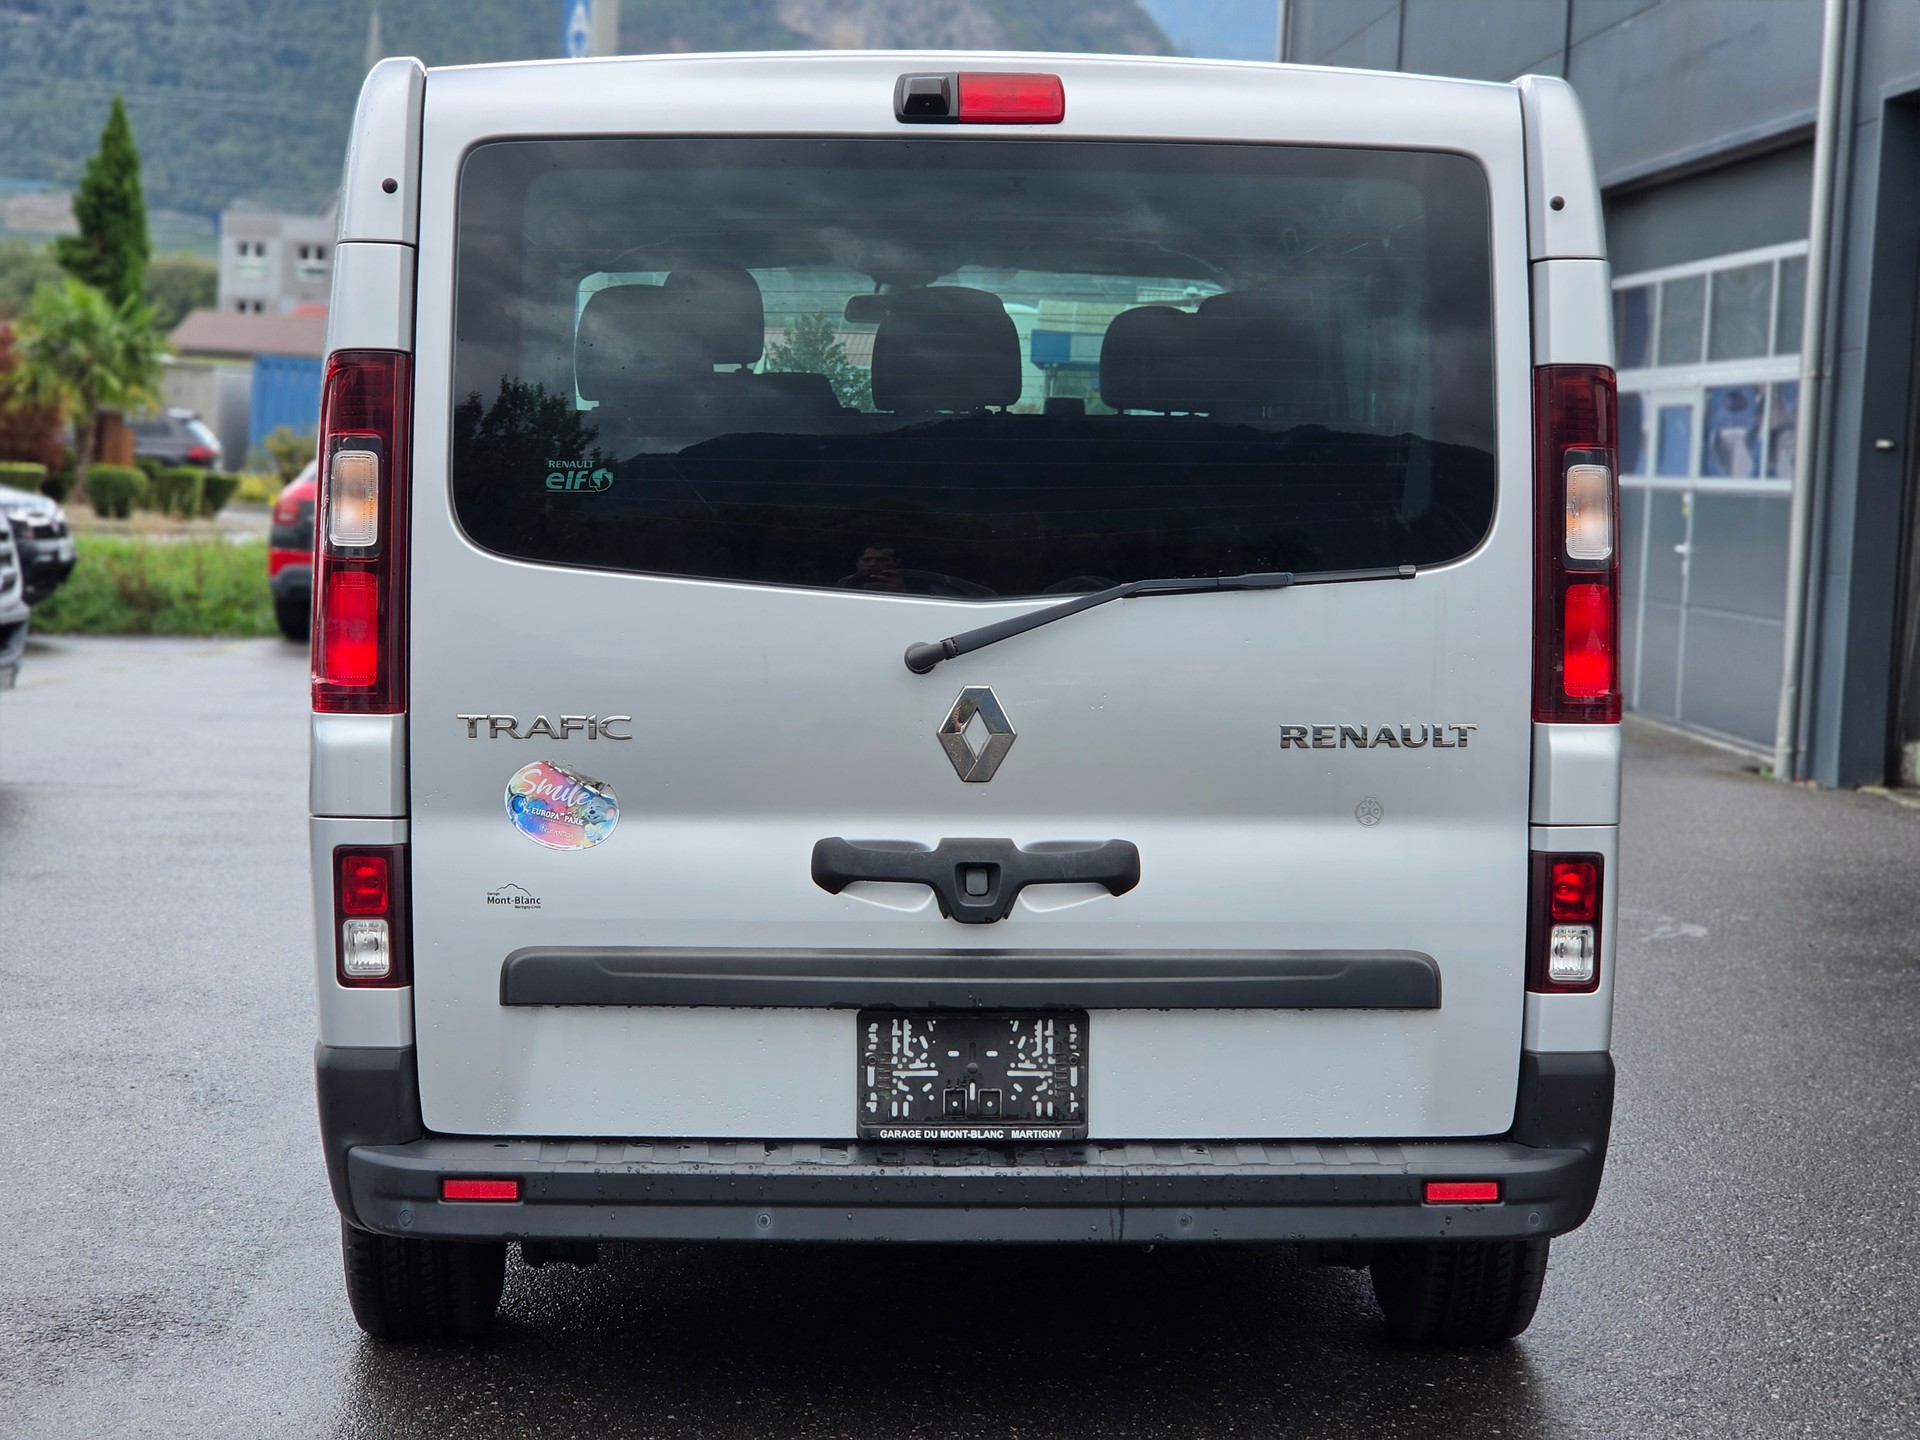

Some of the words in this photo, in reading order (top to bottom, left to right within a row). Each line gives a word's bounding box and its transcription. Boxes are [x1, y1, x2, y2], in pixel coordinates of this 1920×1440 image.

[548, 460, 595, 468] RENAULT
[546, 470, 589, 490] elf
[457, 713, 633, 741] TRAFIC
[1279, 723, 1478, 749] RENAULT
[517, 768, 591, 807] Smile
[531, 807, 560, 820] EUROPA
[563, 815, 585, 826] PARK
[487, 895, 542, 905] Mont-Blanc
[879, 1129, 922, 1139] GARAGE
[923, 1129, 938, 1139] DU
[940, 1129, 1004, 1139] MONT-BLANC
[1011, 1129, 1063, 1139] MARTIGNY
